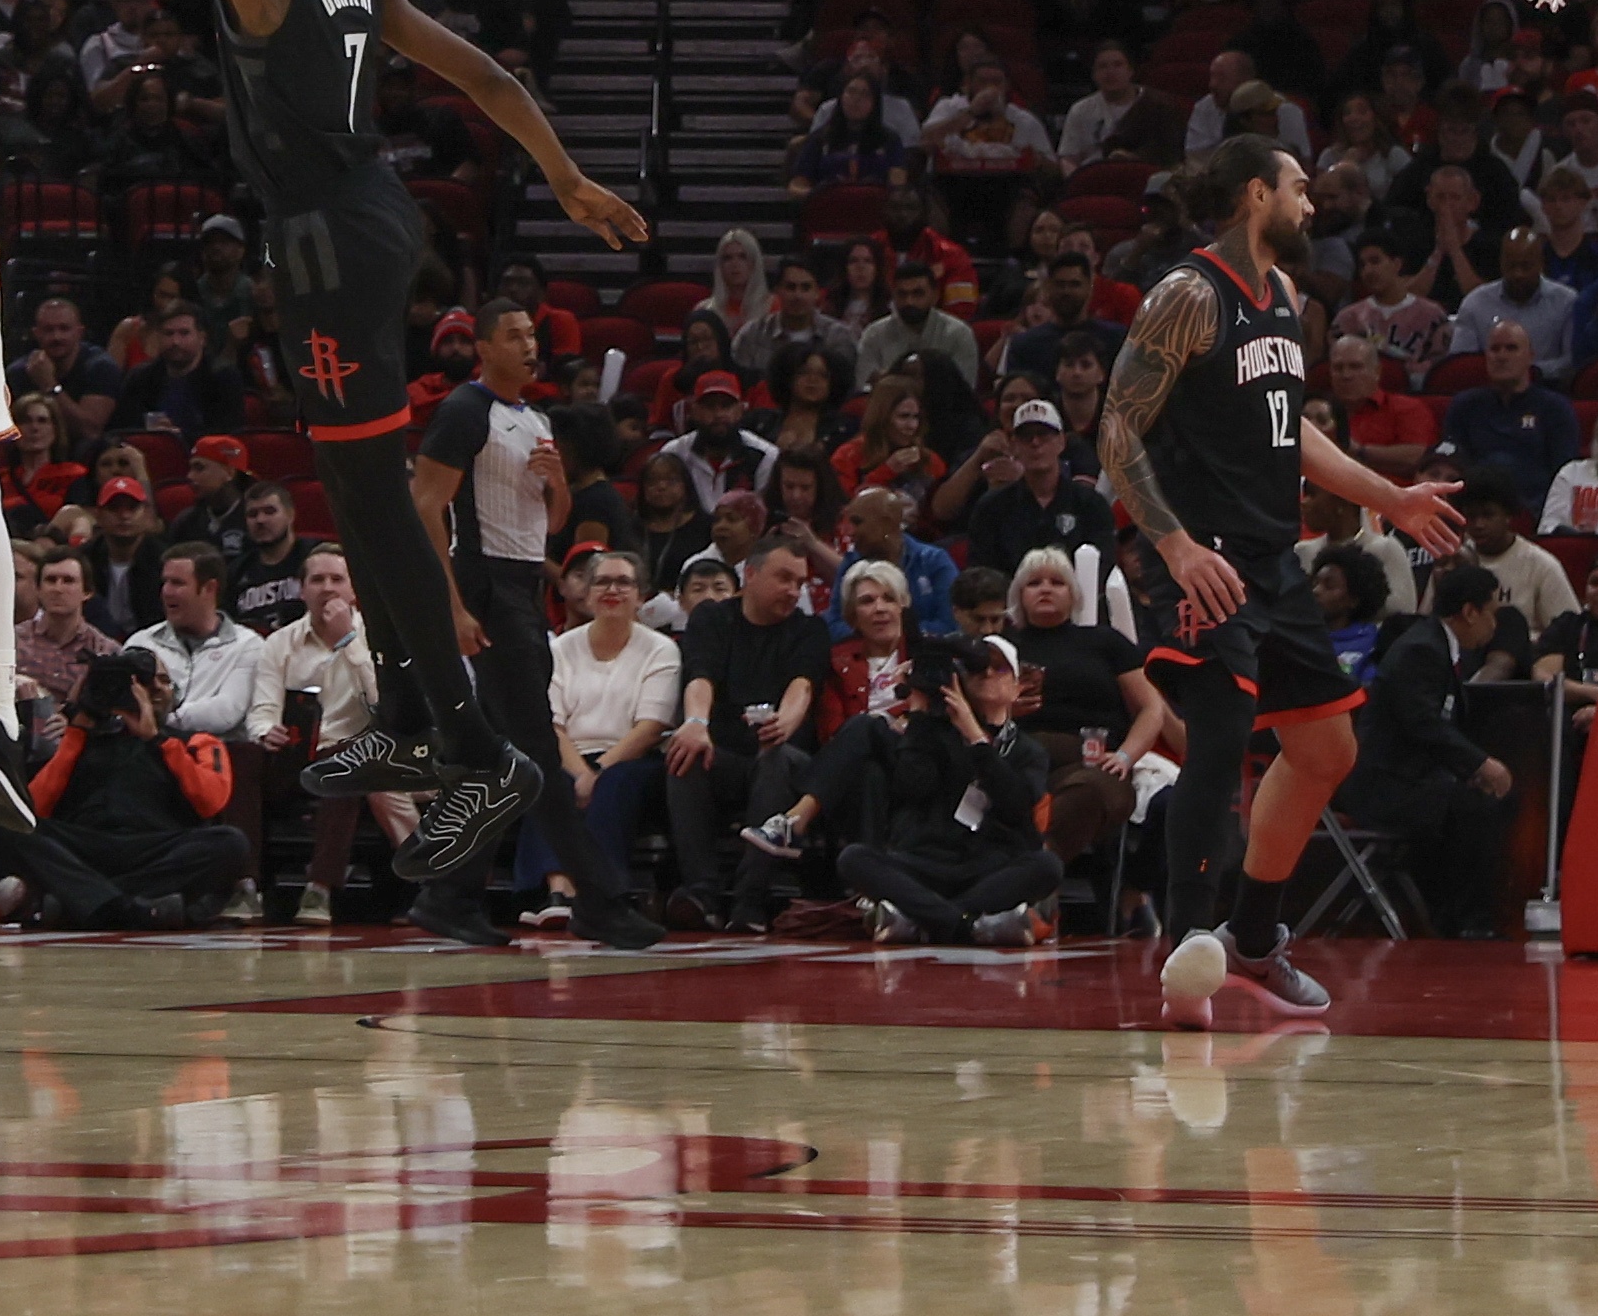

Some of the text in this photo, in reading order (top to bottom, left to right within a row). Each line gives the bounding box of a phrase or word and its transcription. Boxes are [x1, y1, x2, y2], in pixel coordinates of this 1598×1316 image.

[343, 32, 369, 134] 7
[1235, 335, 1306, 386] HOUSTON
[1265, 389, 1296, 448] 12
